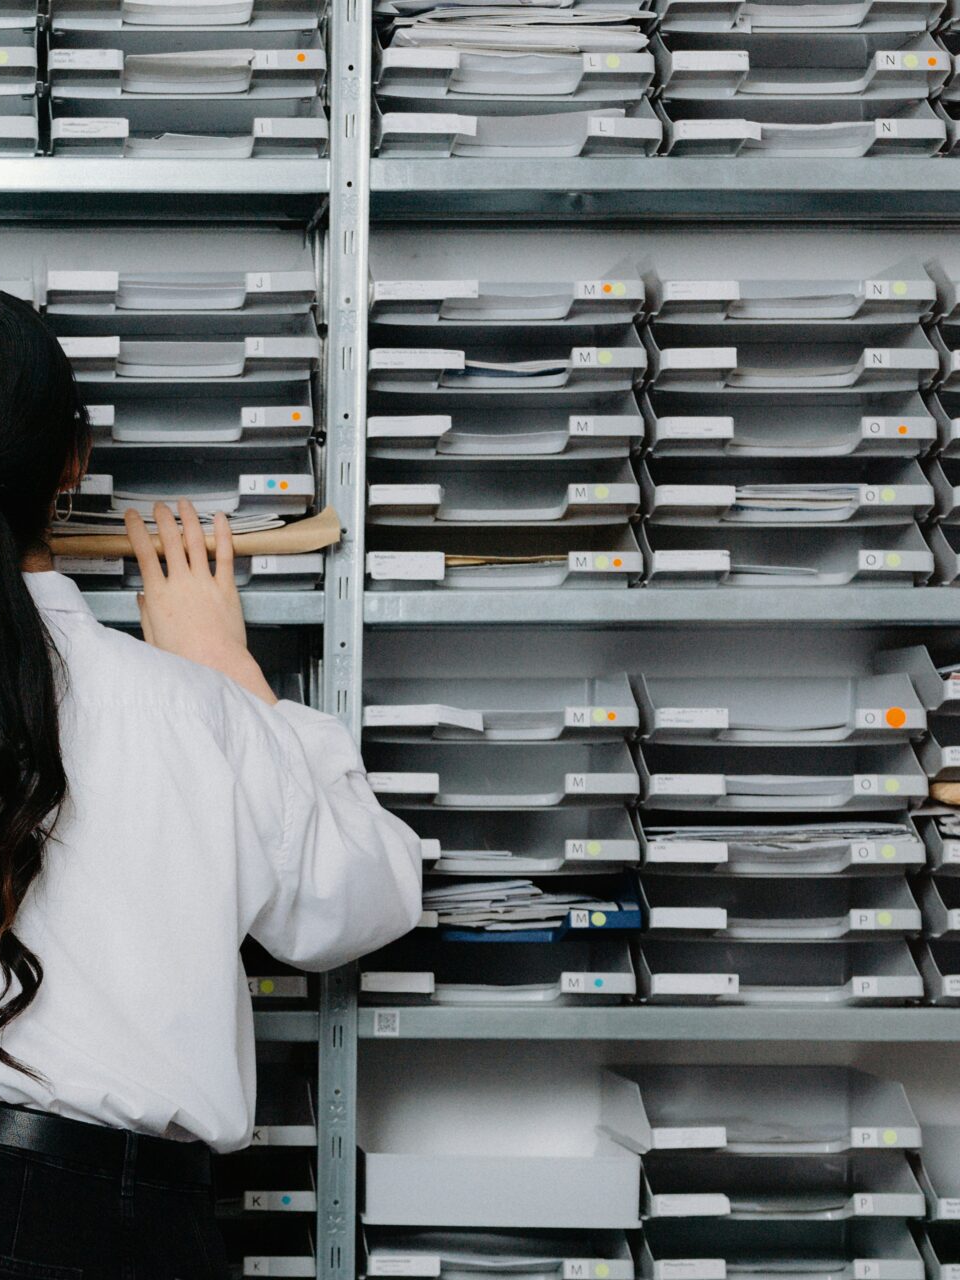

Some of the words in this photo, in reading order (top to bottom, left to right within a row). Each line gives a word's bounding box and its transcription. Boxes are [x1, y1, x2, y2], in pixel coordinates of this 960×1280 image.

[589, 57, 596, 67] L
[886, 55, 895, 65] N
[599, 121, 606, 132] L
[882, 122, 891, 132] N
[256, 277, 263, 289] J
[584, 284, 595, 295] M
[873, 284, 882, 295] N
[253, 340, 260, 352] J
[579, 352, 590, 362] M
[873, 354, 882, 364] N
[250, 412, 257, 424] J
[577, 421, 588, 431] M
[870, 422, 881, 434] O
[249, 480, 256, 491] J
[575, 487, 586, 497] M
[865, 490, 876, 502] O
[260, 560, 269, 570] J
[576, 557, 587, 567] M
[865, 554, 876, 566] O
[573, 712, 584, 723] M
[864, 713, 876, 724] O
[573, 777, 584, 787] M
[860, 778, 872, 790] O
[572, 843, 583, 853] M
[858, 847, 869, 858] O
[575, 913, 587, 924] M
[859, 915, 868, 925] P
[568, 978, 579, 987] M
[861, 982, 870, 992] P
[252, 1130, 261, 1141] K
[862, 1133, 871, 1143] P
[252, 1196, 261, 1206] K
[860, 1198, 868, 1208] P
[253, 1262, 260, 1271] K
[571, 1265, 582, 1275] M
